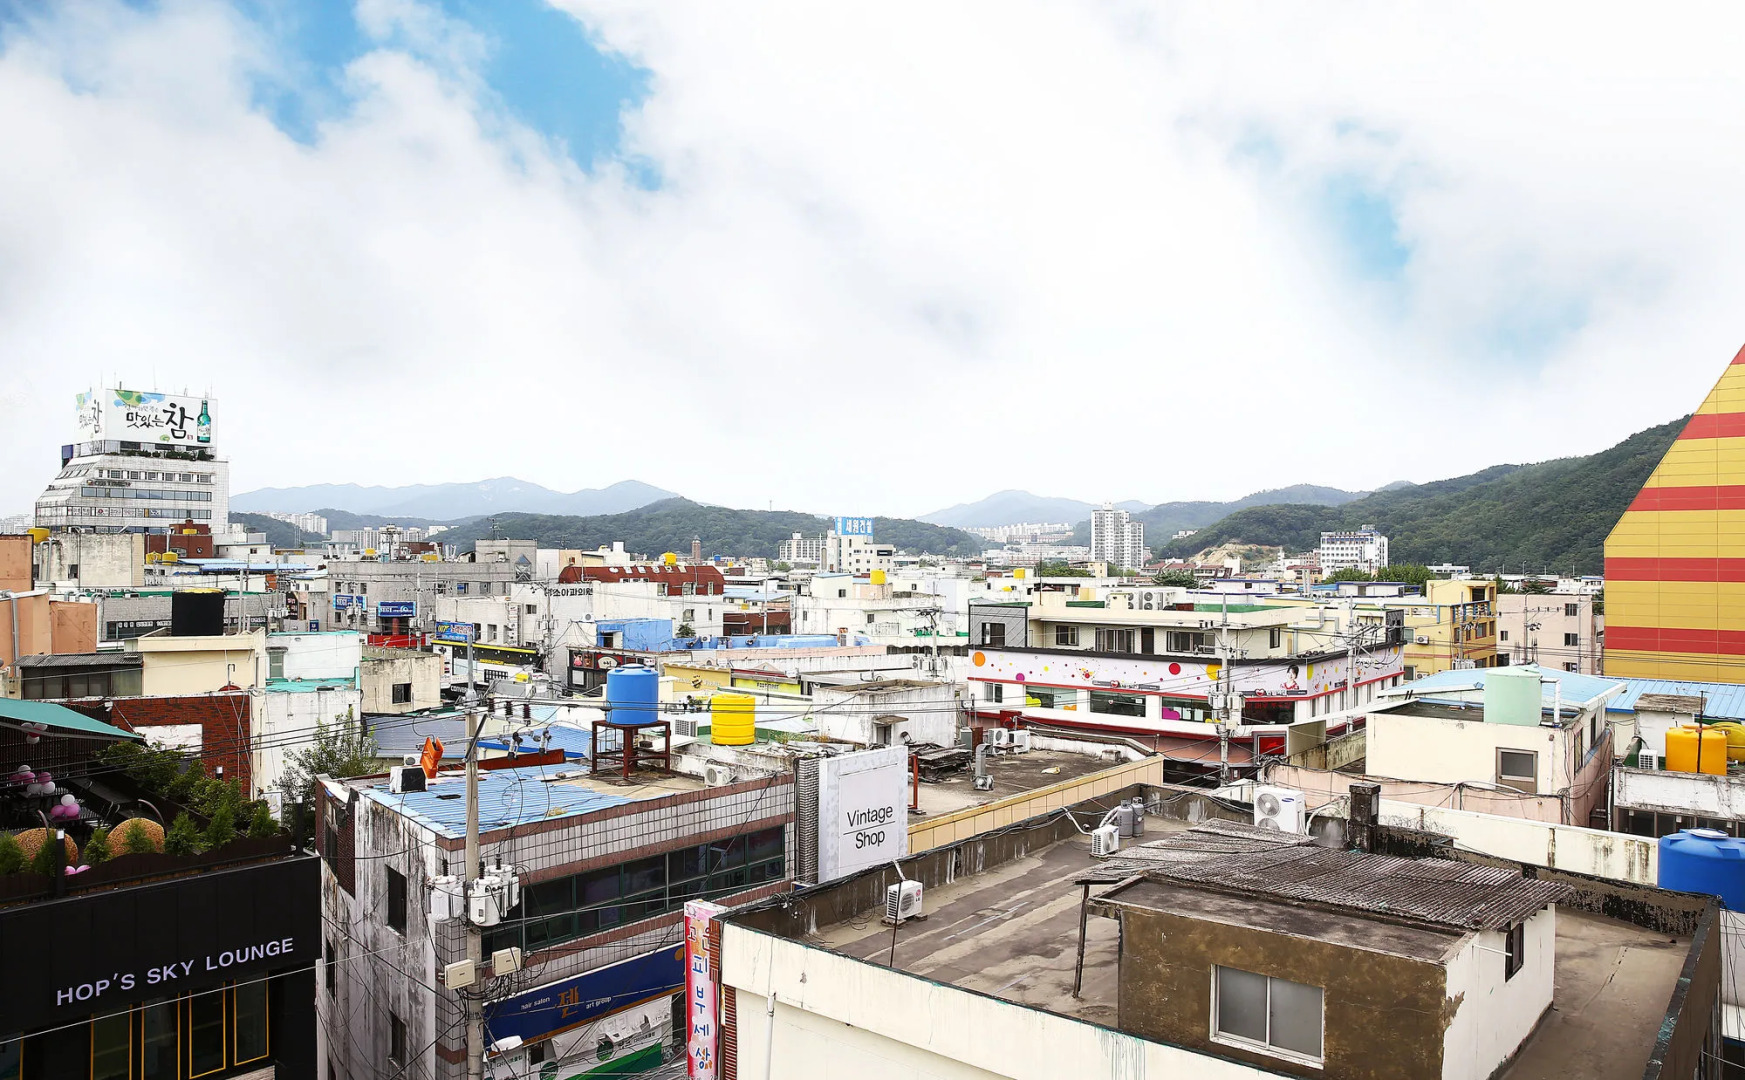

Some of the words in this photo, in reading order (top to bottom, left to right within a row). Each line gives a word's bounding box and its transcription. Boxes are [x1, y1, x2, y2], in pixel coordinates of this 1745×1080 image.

[126, 411, 164, 429] 맛있는
[162, 402, 194, 439] 참
[846, 519, 873, 534] 세원건설
[847, 806, 894, 827] Vintage
[856, 831, 886, 849] Shop
[56, 973, 136, 1006] HOP'S
[147, 960, 195, 985] SKY
[206, 938, 294, 971] LOUNGE
[520, 1001, 532, 1011] hair
[533, 996, 551, 1007] salon
[586, 1001, 596, 1010] art
[596, 996, 612, 1008] group
[692, 955, 712, 1070] 피부세상
